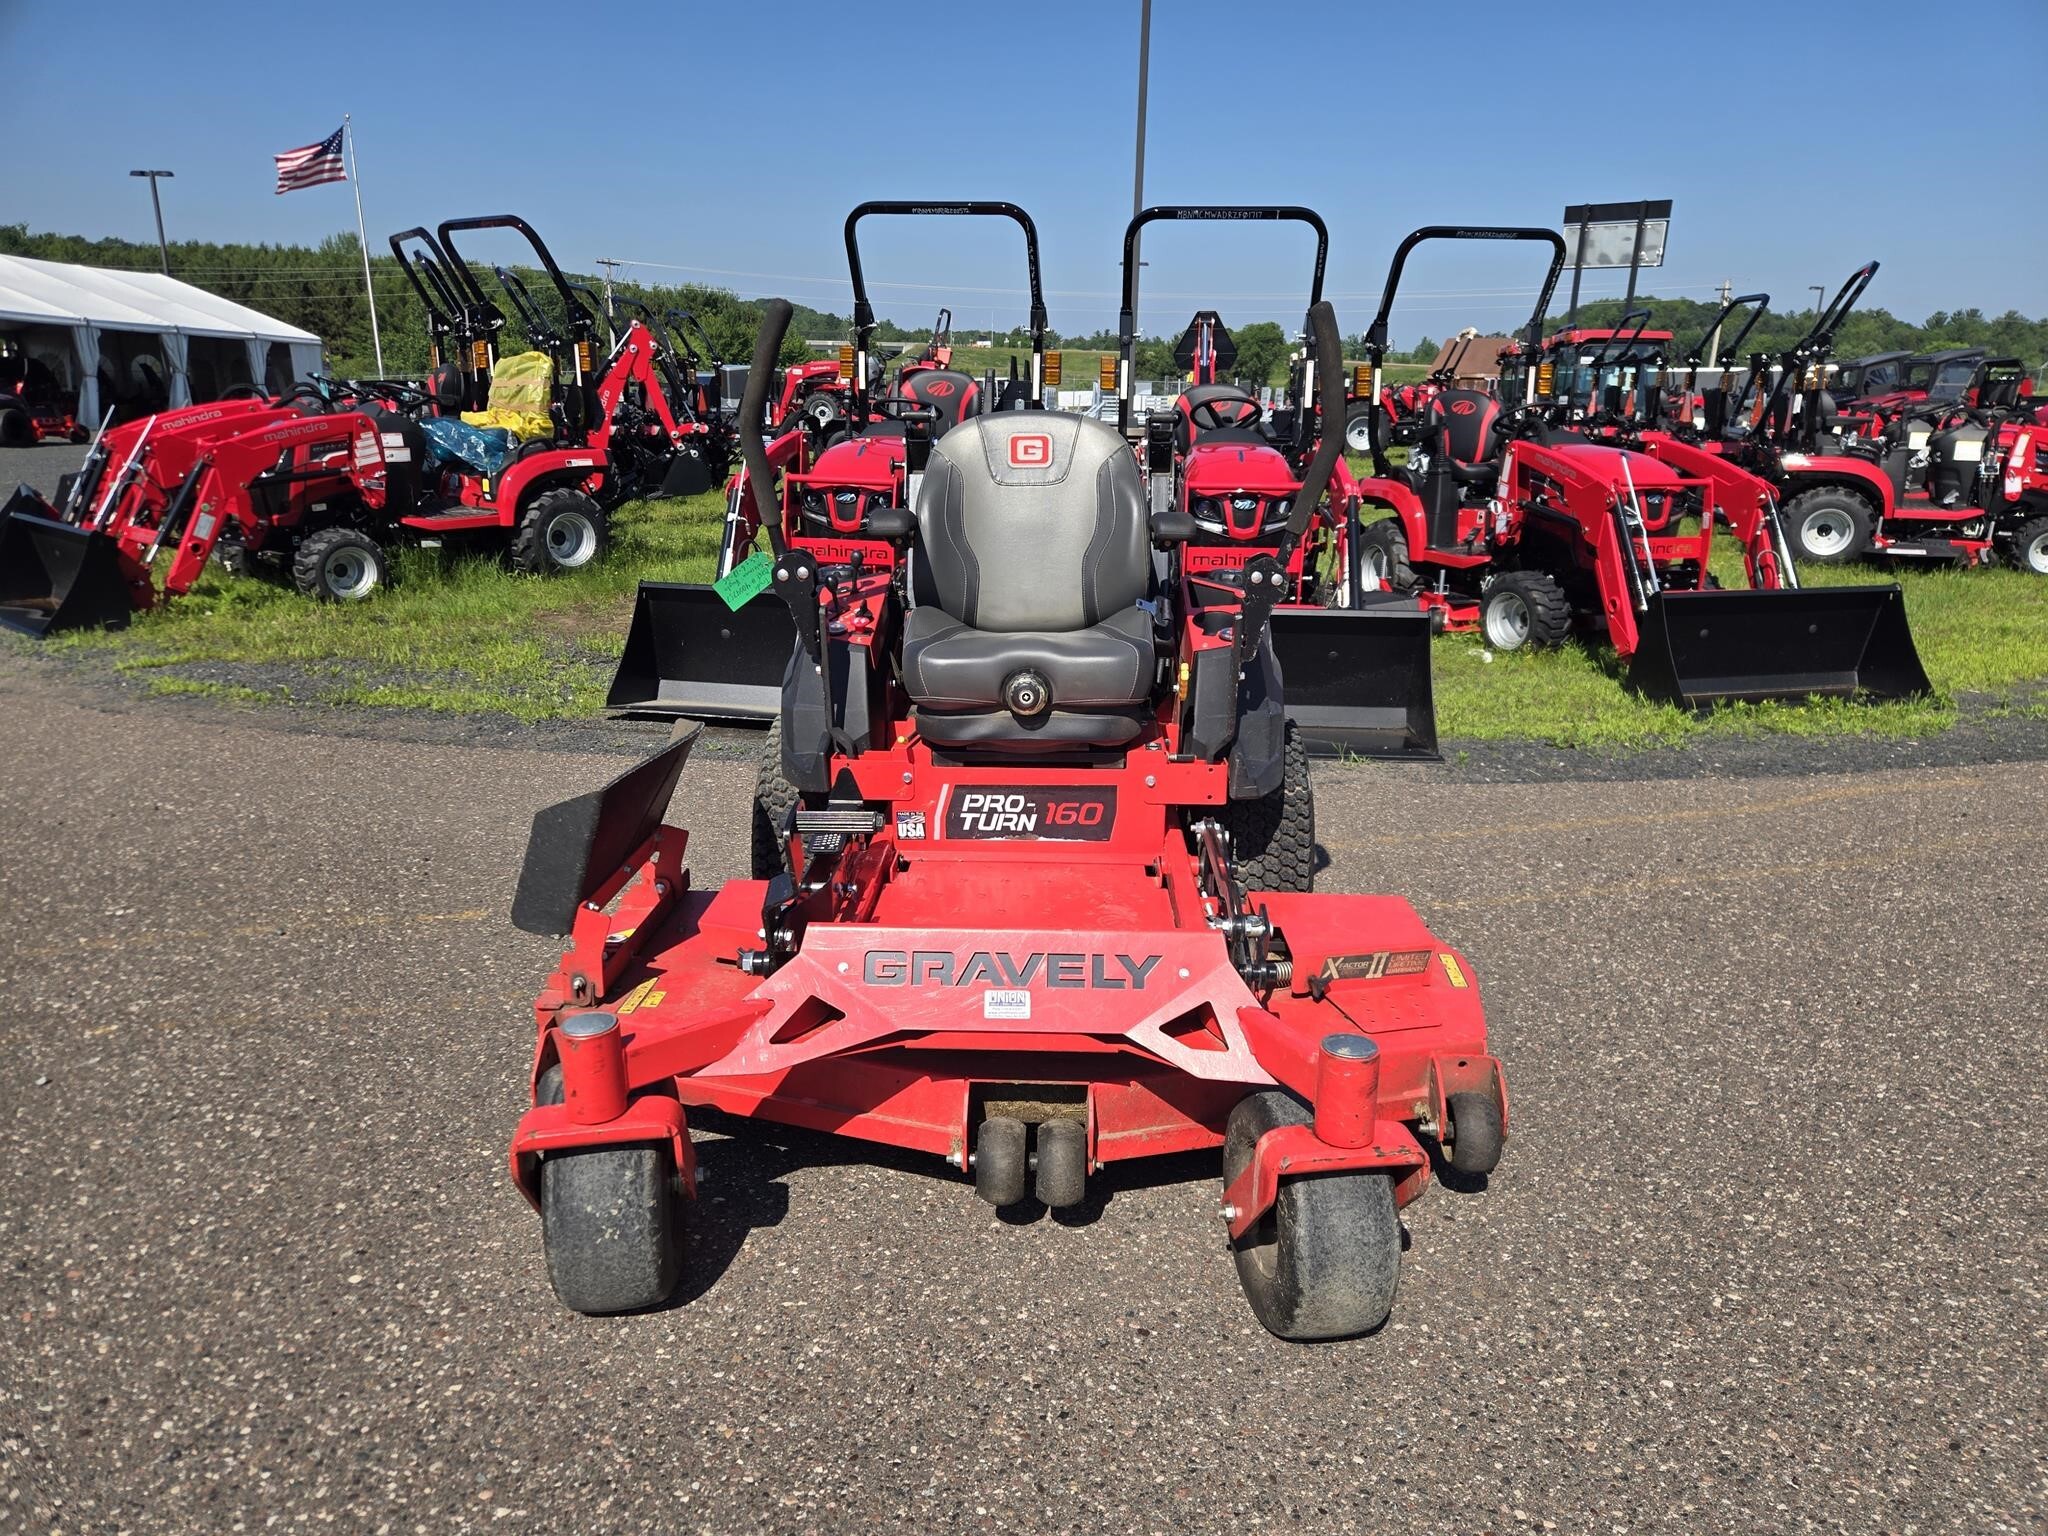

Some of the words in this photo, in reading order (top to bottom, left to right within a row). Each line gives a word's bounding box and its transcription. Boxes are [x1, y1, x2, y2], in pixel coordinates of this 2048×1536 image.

[161, 409, 223, 431] mahindra
[263, 422, 329, 442] mahindra
[962, 794, 1036, 813] PRO-
[960, 812, 1038, 832] TURN
[1045, 802, 1105, 826] 160
[897, 823, 926, 838] USA
[864, 950, 1164, 990] GRAVELY
